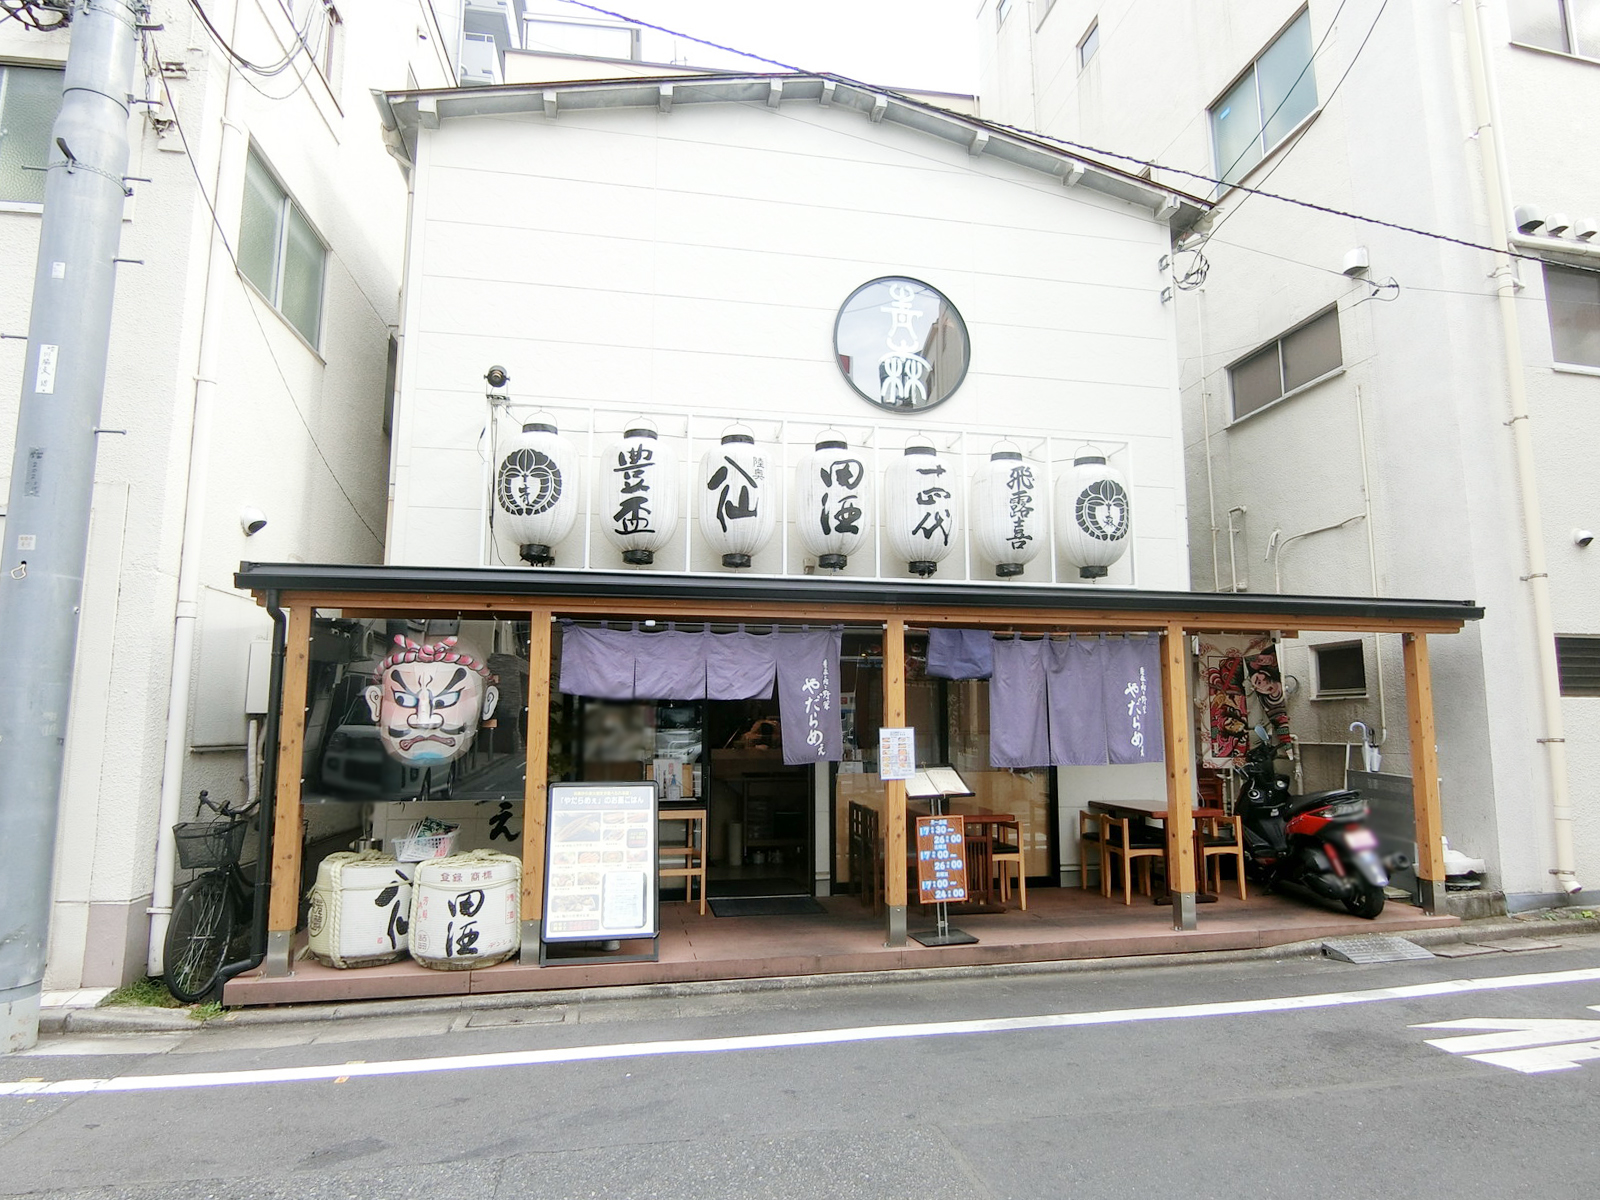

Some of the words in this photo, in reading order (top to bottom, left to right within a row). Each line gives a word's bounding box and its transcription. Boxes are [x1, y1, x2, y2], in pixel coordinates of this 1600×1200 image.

[707, 455, 758, 532] 八仙
[820, 459, 864, 536] 田酒
[912, 464, 952, 546] 十四代
[1006, 465, 1035, 550] 飛露喜
[933, 834, 962, 844] 26:00
[934, 860, 962, 871] 26:00
[446, 889, 485, 957] 田酒
[935, 888, 964, 899] 24:00
